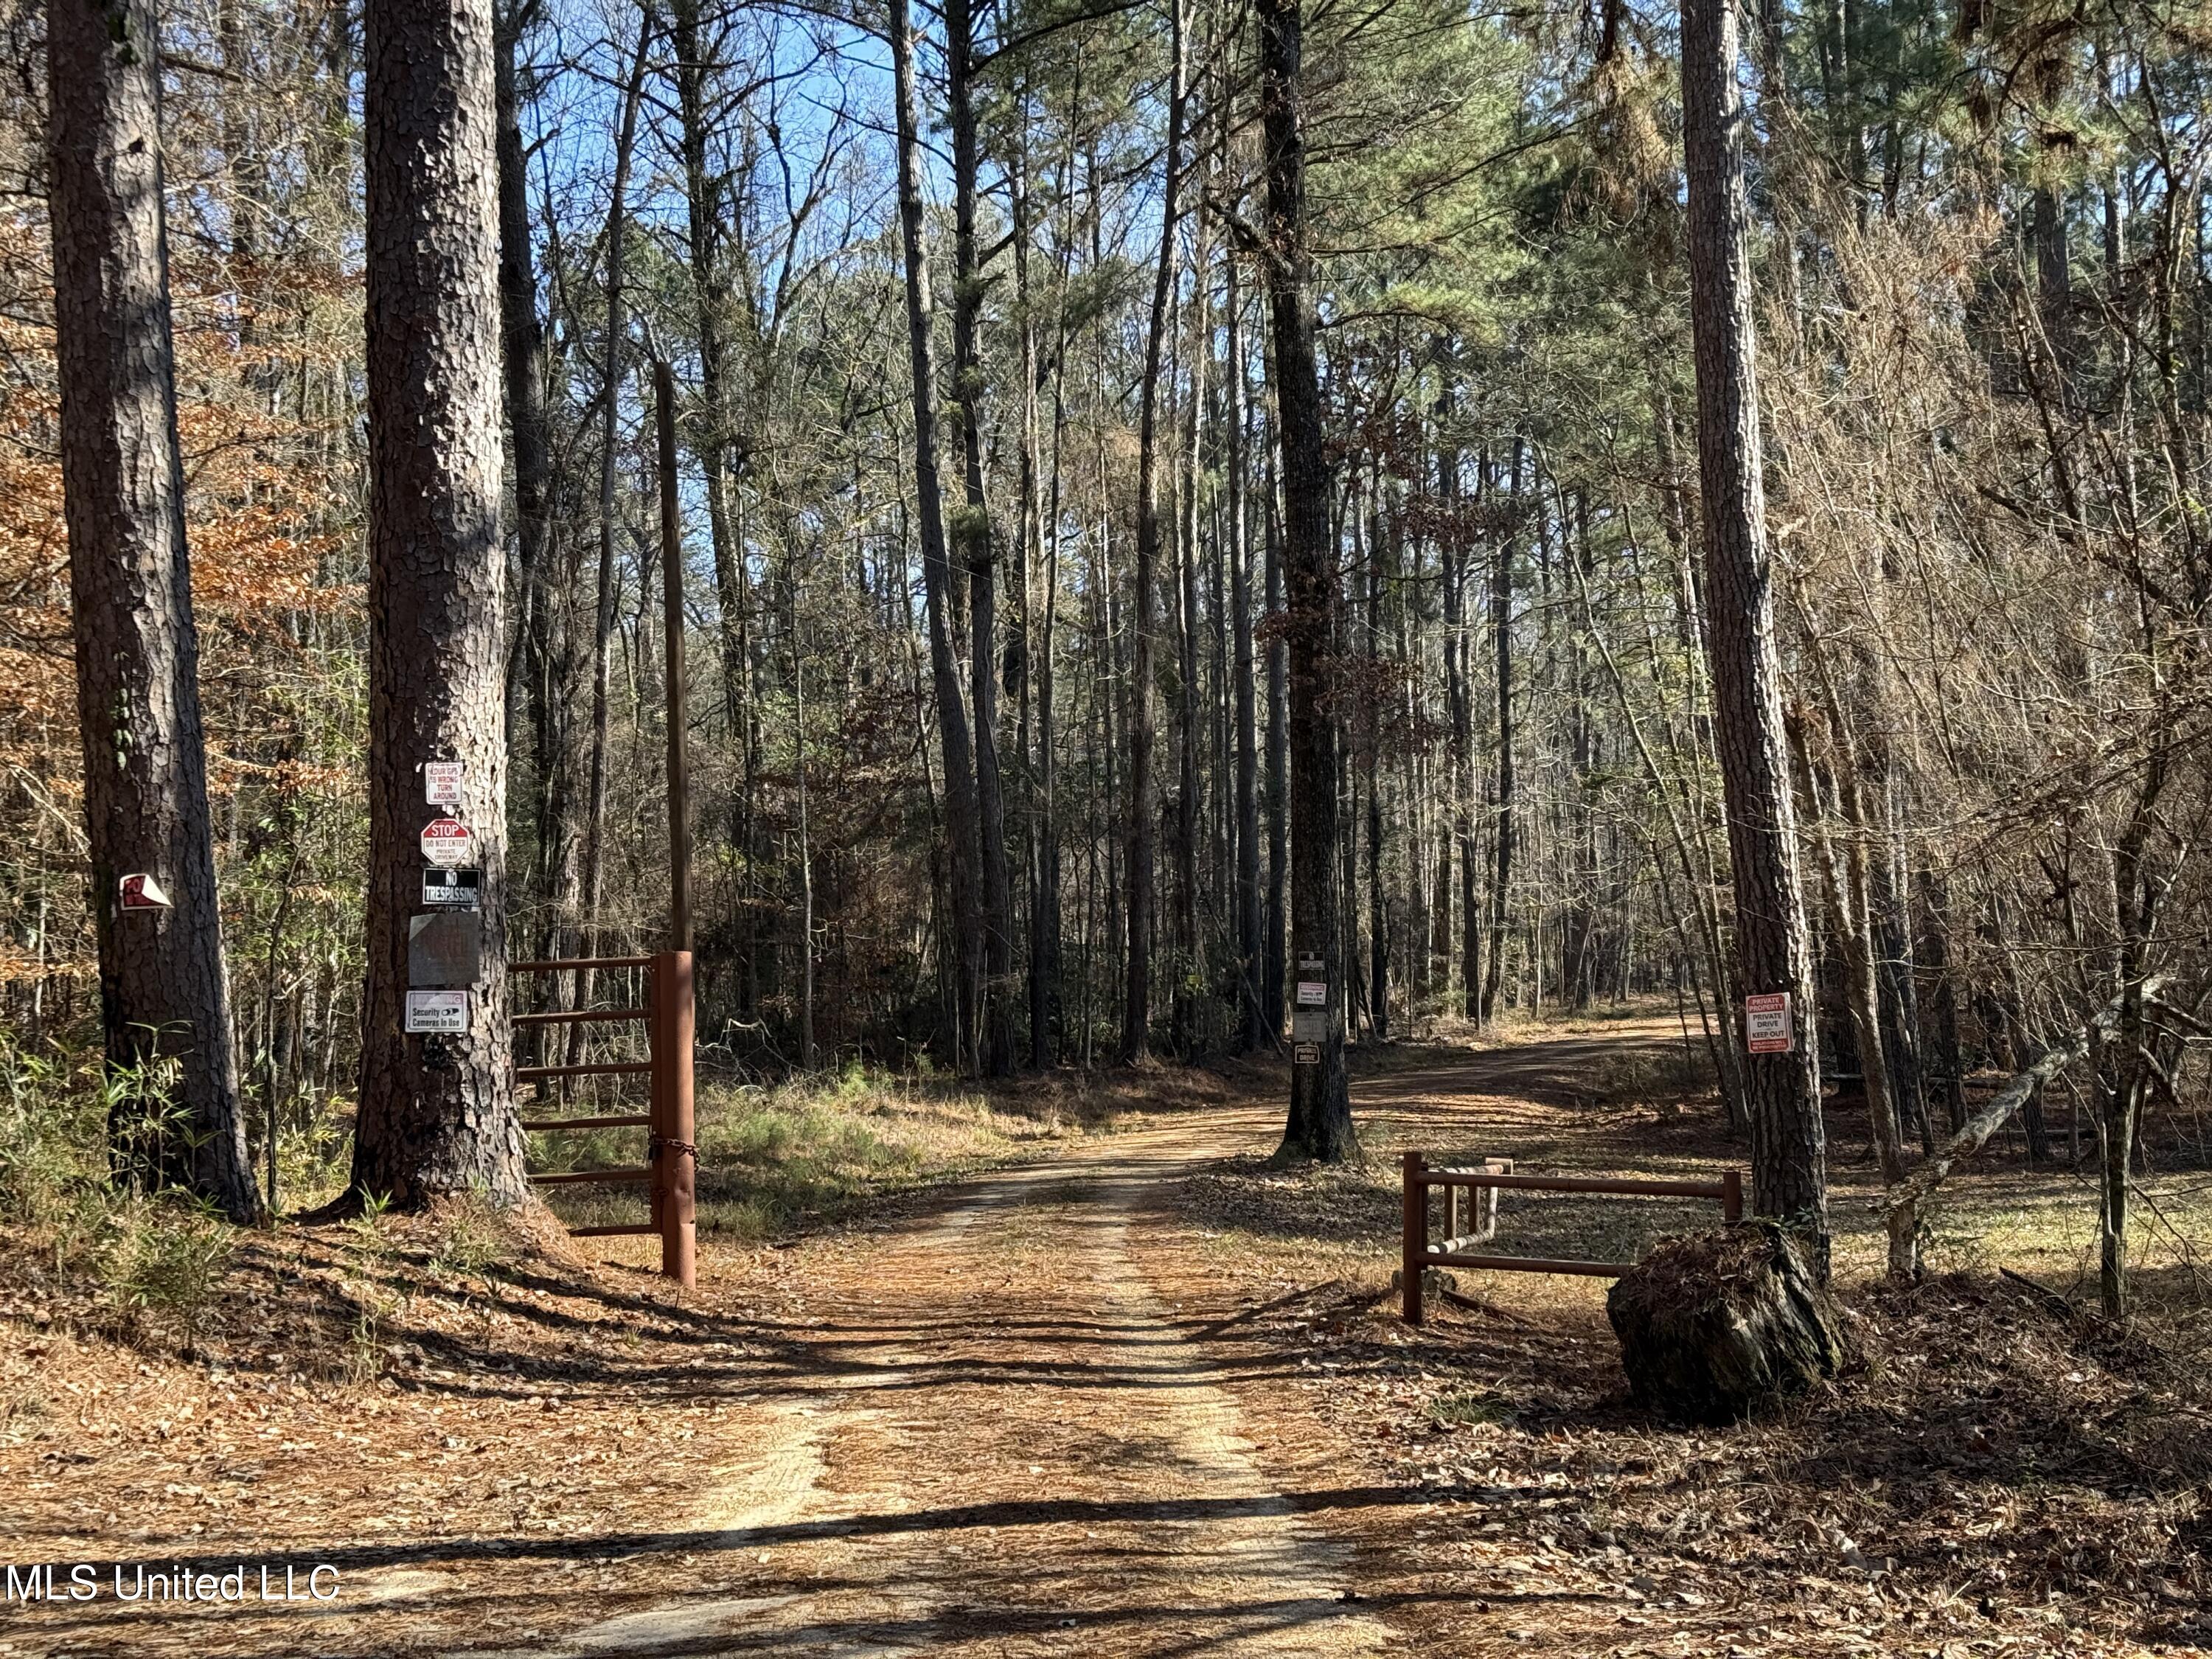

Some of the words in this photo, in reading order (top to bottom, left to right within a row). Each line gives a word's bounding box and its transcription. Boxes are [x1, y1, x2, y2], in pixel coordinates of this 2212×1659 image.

[431, 824, 459, 836] STOP
[448, 839, 466, 847] ENTER
[445, 872, 457, 886] NO
[425, 886, 478, 902] TRESPASSING
[1752, 997, 1780, 1005] PRIVATE
[1749, 1004, 1784, 1012] PROPERTY
[413, 1008, 440, 1018] Security
[413, 1018, 439, 1027] Cameras
[448, 1019, 459, 1027] Use
